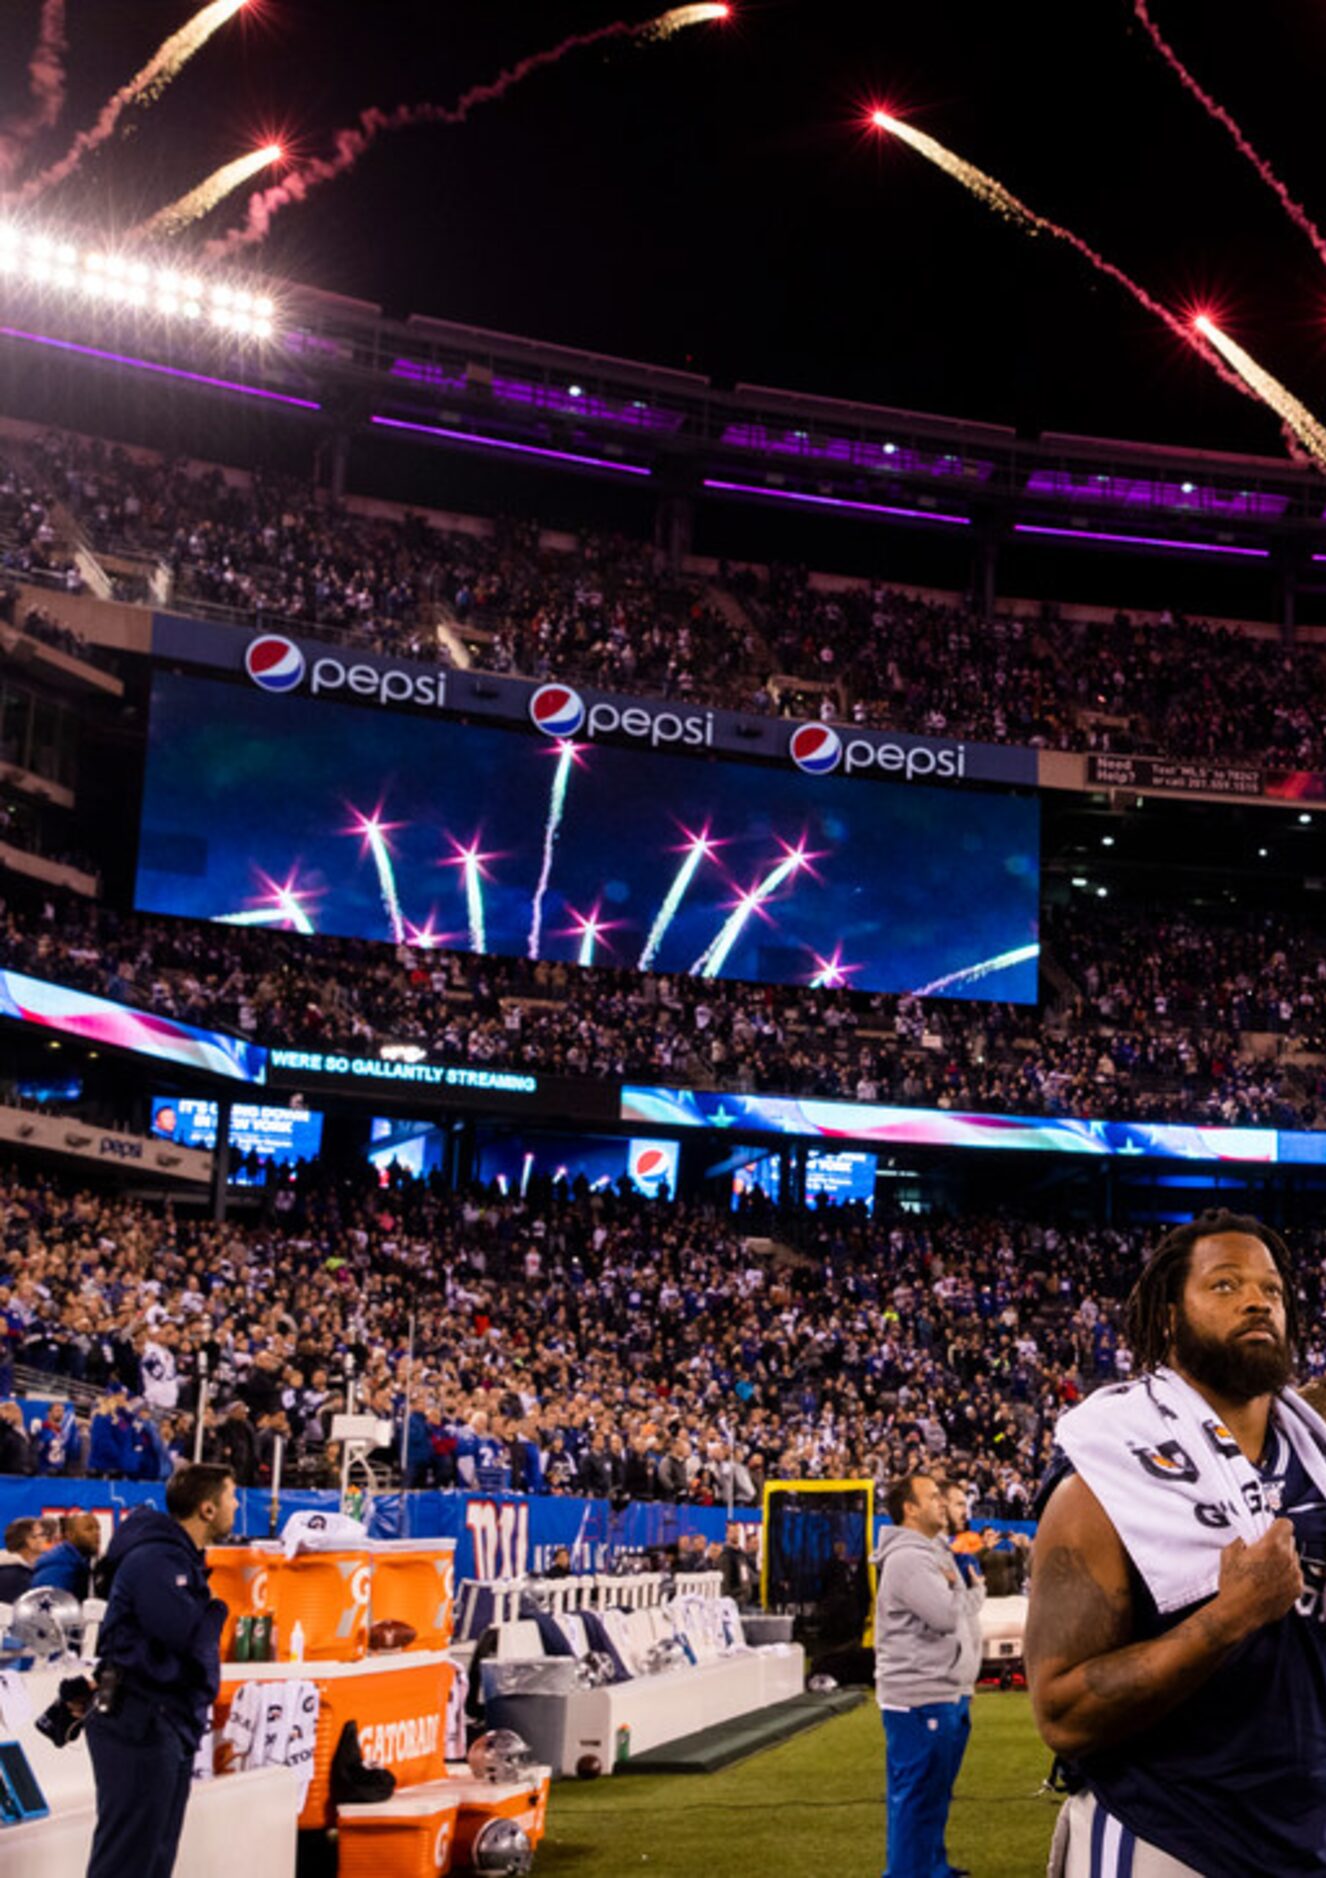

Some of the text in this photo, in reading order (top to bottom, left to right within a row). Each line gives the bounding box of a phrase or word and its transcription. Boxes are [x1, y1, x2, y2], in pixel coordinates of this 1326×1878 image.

[310, 657, 446, 707] pepsi
[588, 702, 714, 747] pepsi
[845, 740, 966, 780] pepsi
[270, 1050, 537, 1092] WERE SO GALLANTLY STREAMING
